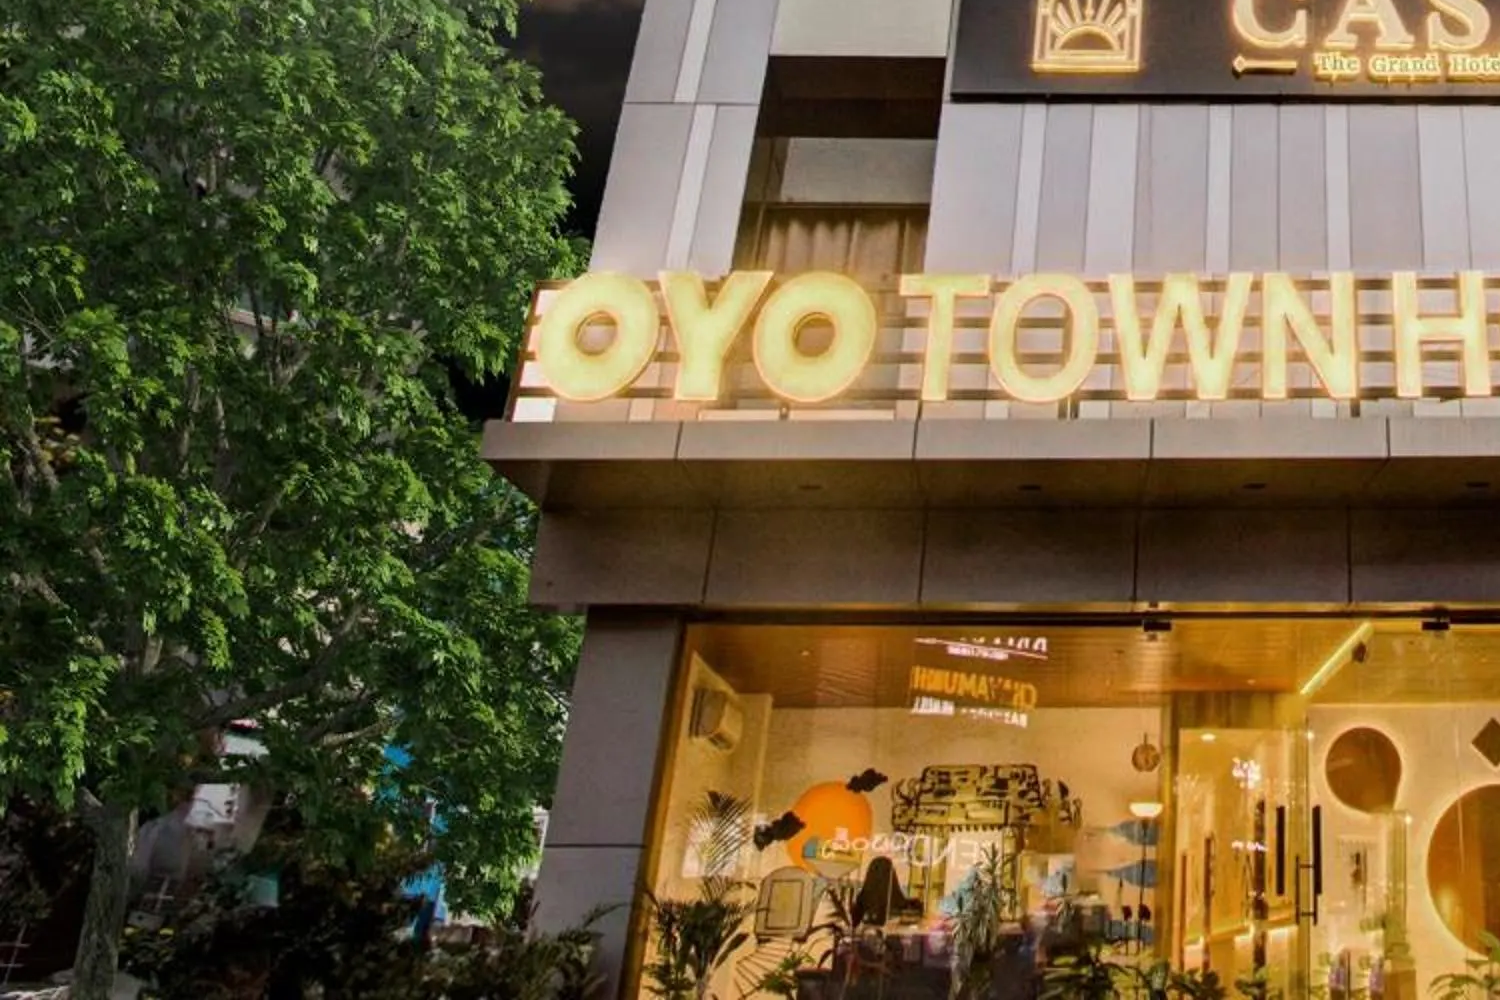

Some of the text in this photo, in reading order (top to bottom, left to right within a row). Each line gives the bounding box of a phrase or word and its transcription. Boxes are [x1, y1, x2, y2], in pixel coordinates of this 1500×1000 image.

[1314, 52, 1361, 78] The
[1367, 51, 1442, 78] Grand
[537, 269, 878, 402] OYO
